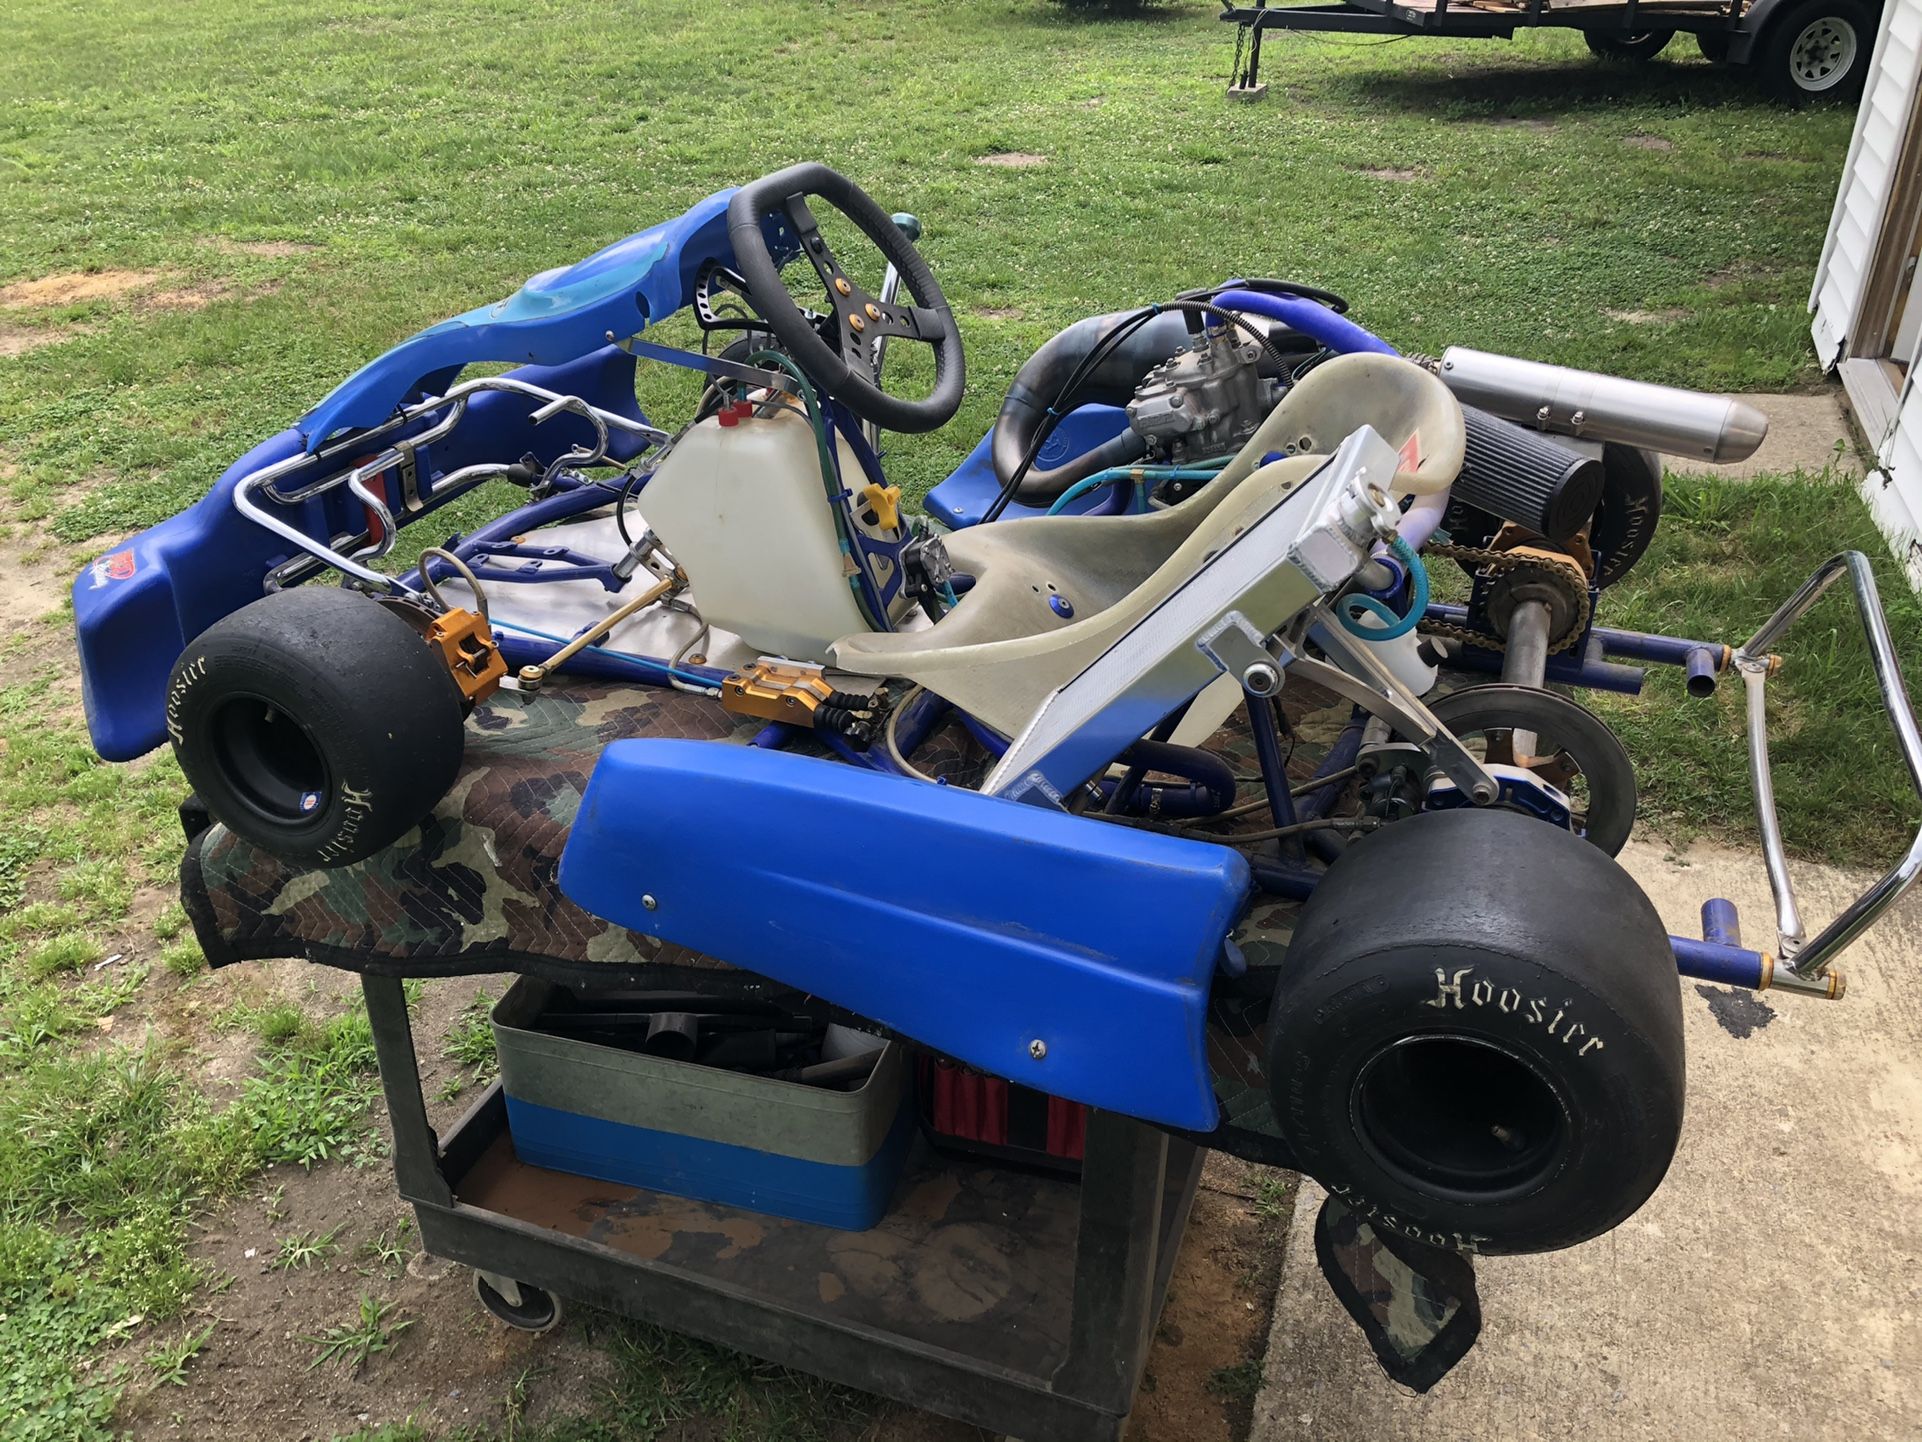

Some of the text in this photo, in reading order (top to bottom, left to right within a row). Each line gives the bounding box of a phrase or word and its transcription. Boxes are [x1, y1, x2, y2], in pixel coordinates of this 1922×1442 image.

[166, 657, 206, 745] Hoosier
[319, 781, 374, 862] Hoosier
[1425, 964, 1604, 1057] Hoosier
